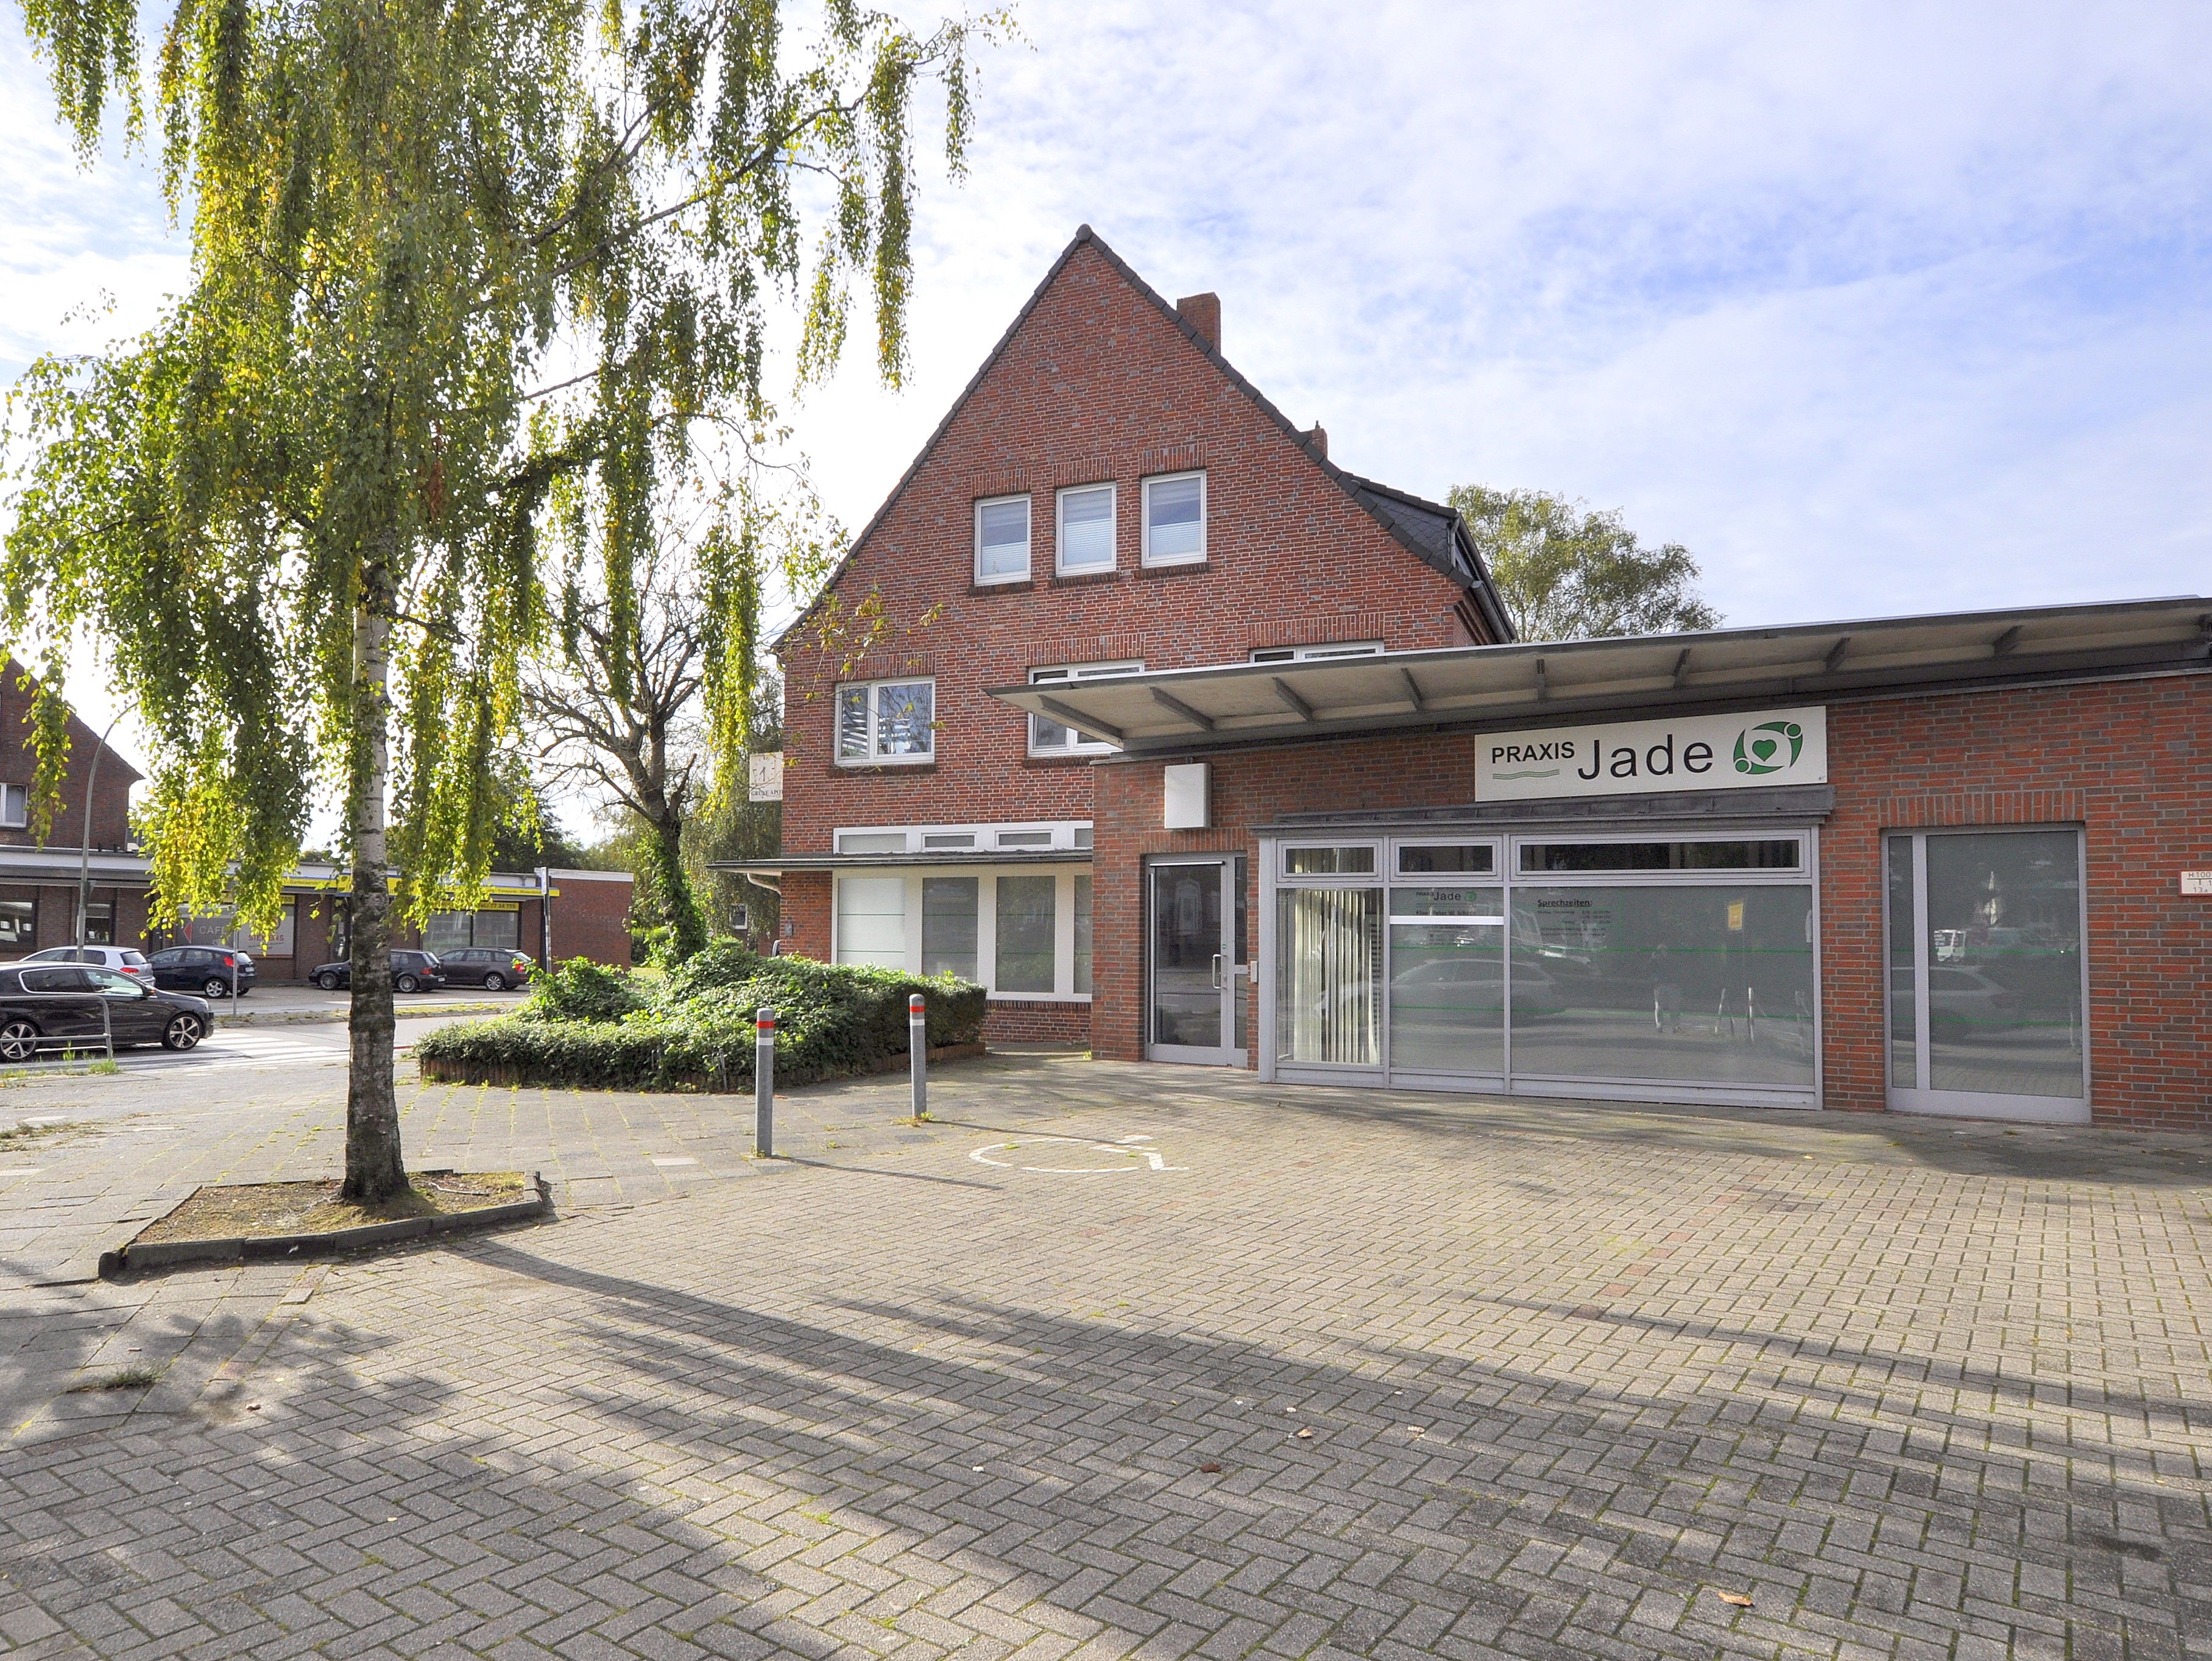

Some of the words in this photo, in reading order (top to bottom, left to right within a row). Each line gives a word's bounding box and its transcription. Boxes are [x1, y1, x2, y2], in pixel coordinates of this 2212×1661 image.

[1491, 742, 1575, 763] PRAXIS
[1578, 734, 1714, 780] Jade
[1433, 891, 1461, 901] Jade
